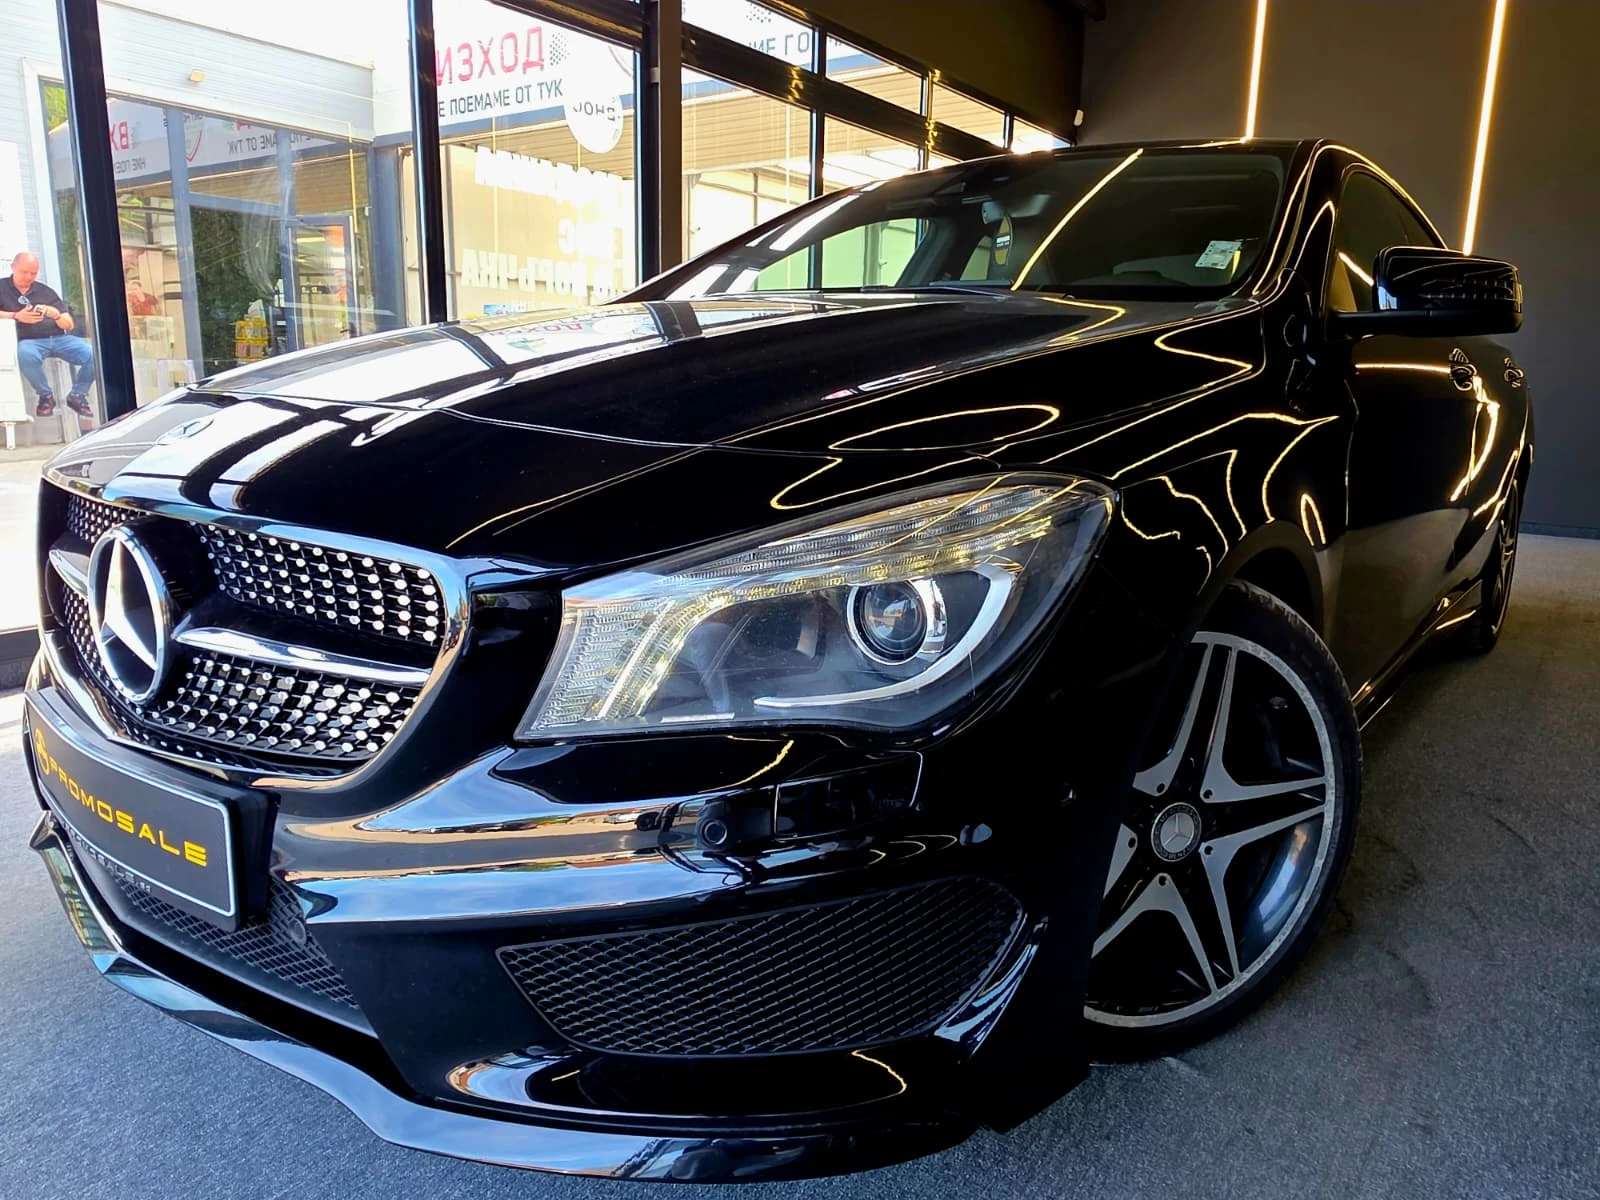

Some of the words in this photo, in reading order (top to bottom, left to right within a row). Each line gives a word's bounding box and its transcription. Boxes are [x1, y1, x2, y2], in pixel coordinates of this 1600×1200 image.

[435, 26, 545, 87] ИЗХОД
[450, 89, 511, 116] ПОЕМАМЕ
[515, 84, 532, 104] ОТ
[537, 78, 563, 100] ТУК
[50, 761, 208, 867] PROMOSALE
